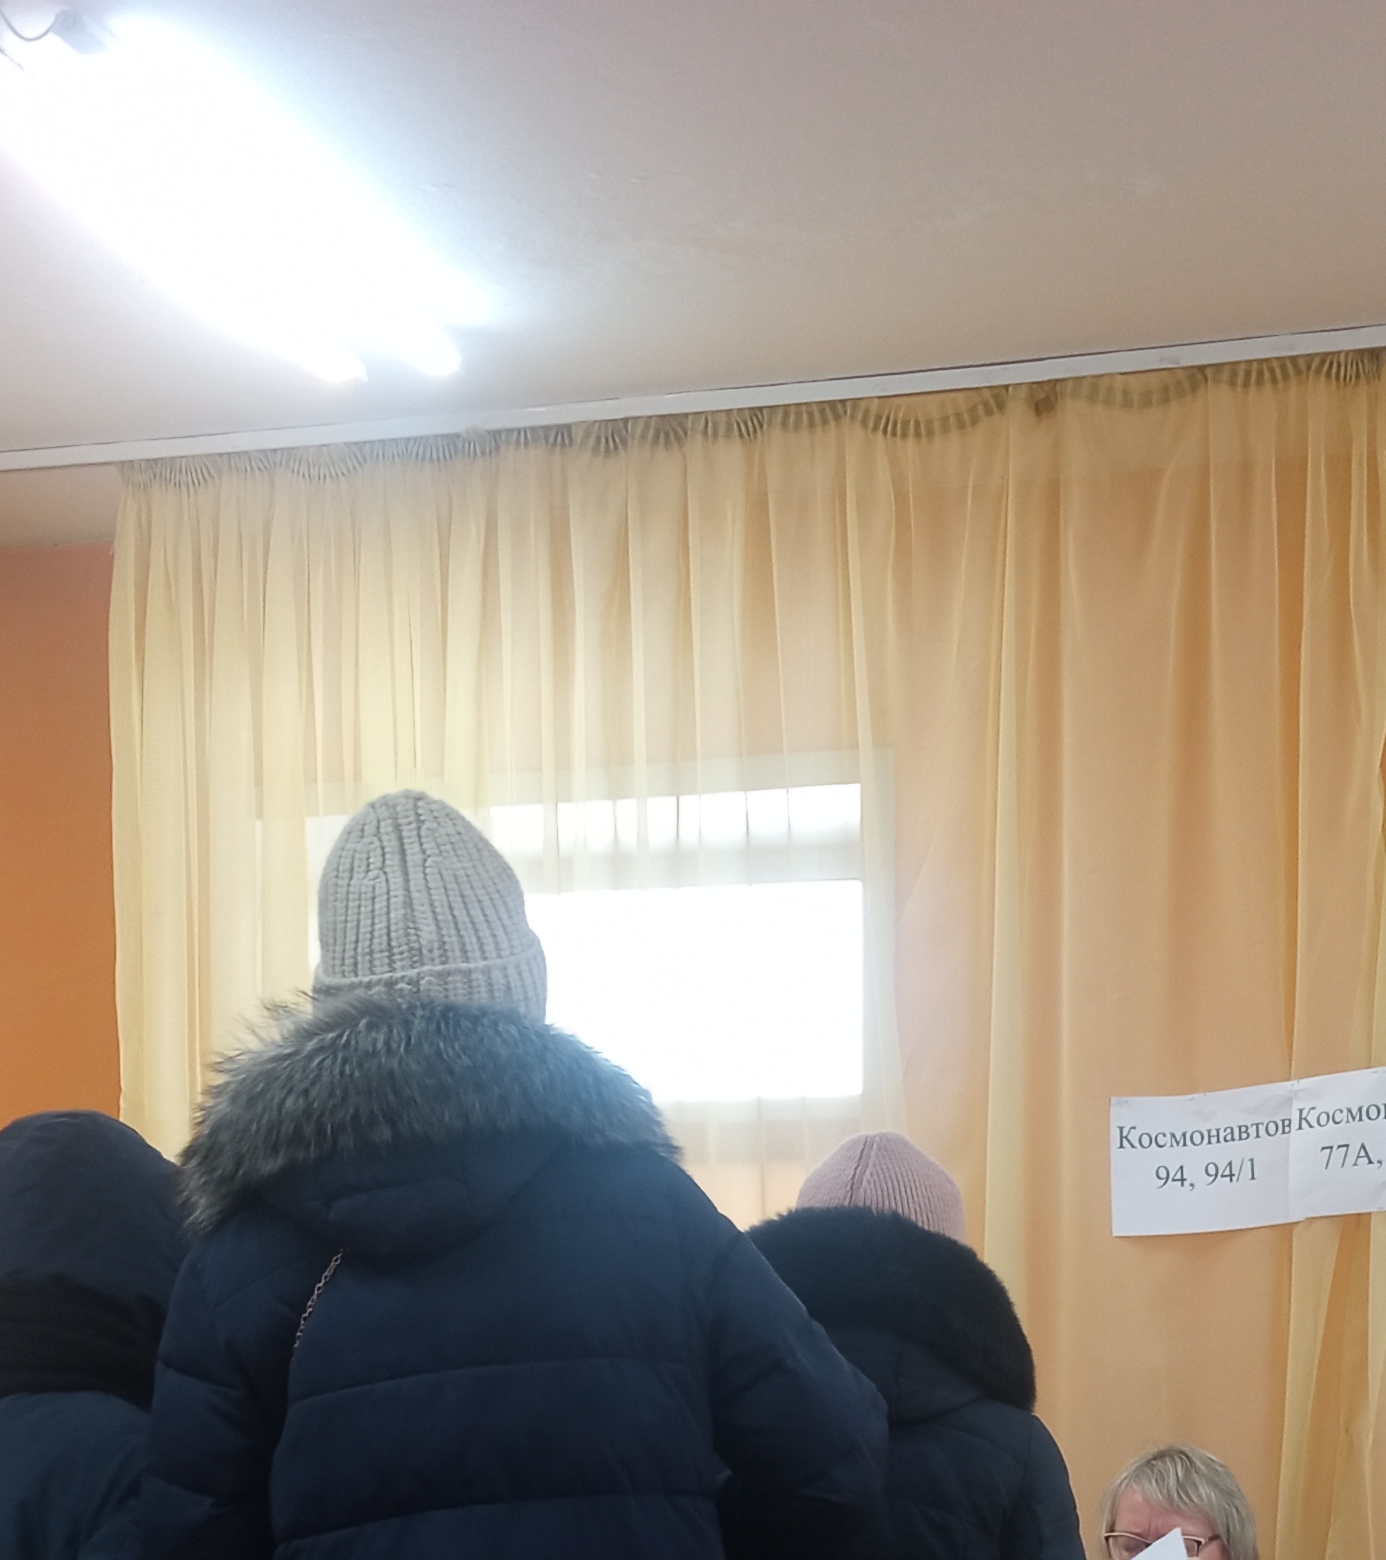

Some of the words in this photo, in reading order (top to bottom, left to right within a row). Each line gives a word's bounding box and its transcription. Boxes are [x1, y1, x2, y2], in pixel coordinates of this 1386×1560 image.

[1117, 1118, 1291, 1150] Космонавтов
[1320, 1141, 1383, 1170] 77А,
[1155, 1164, 1195, 1190] 94,
[1204, 1157, 1257, 1184] 94/1
